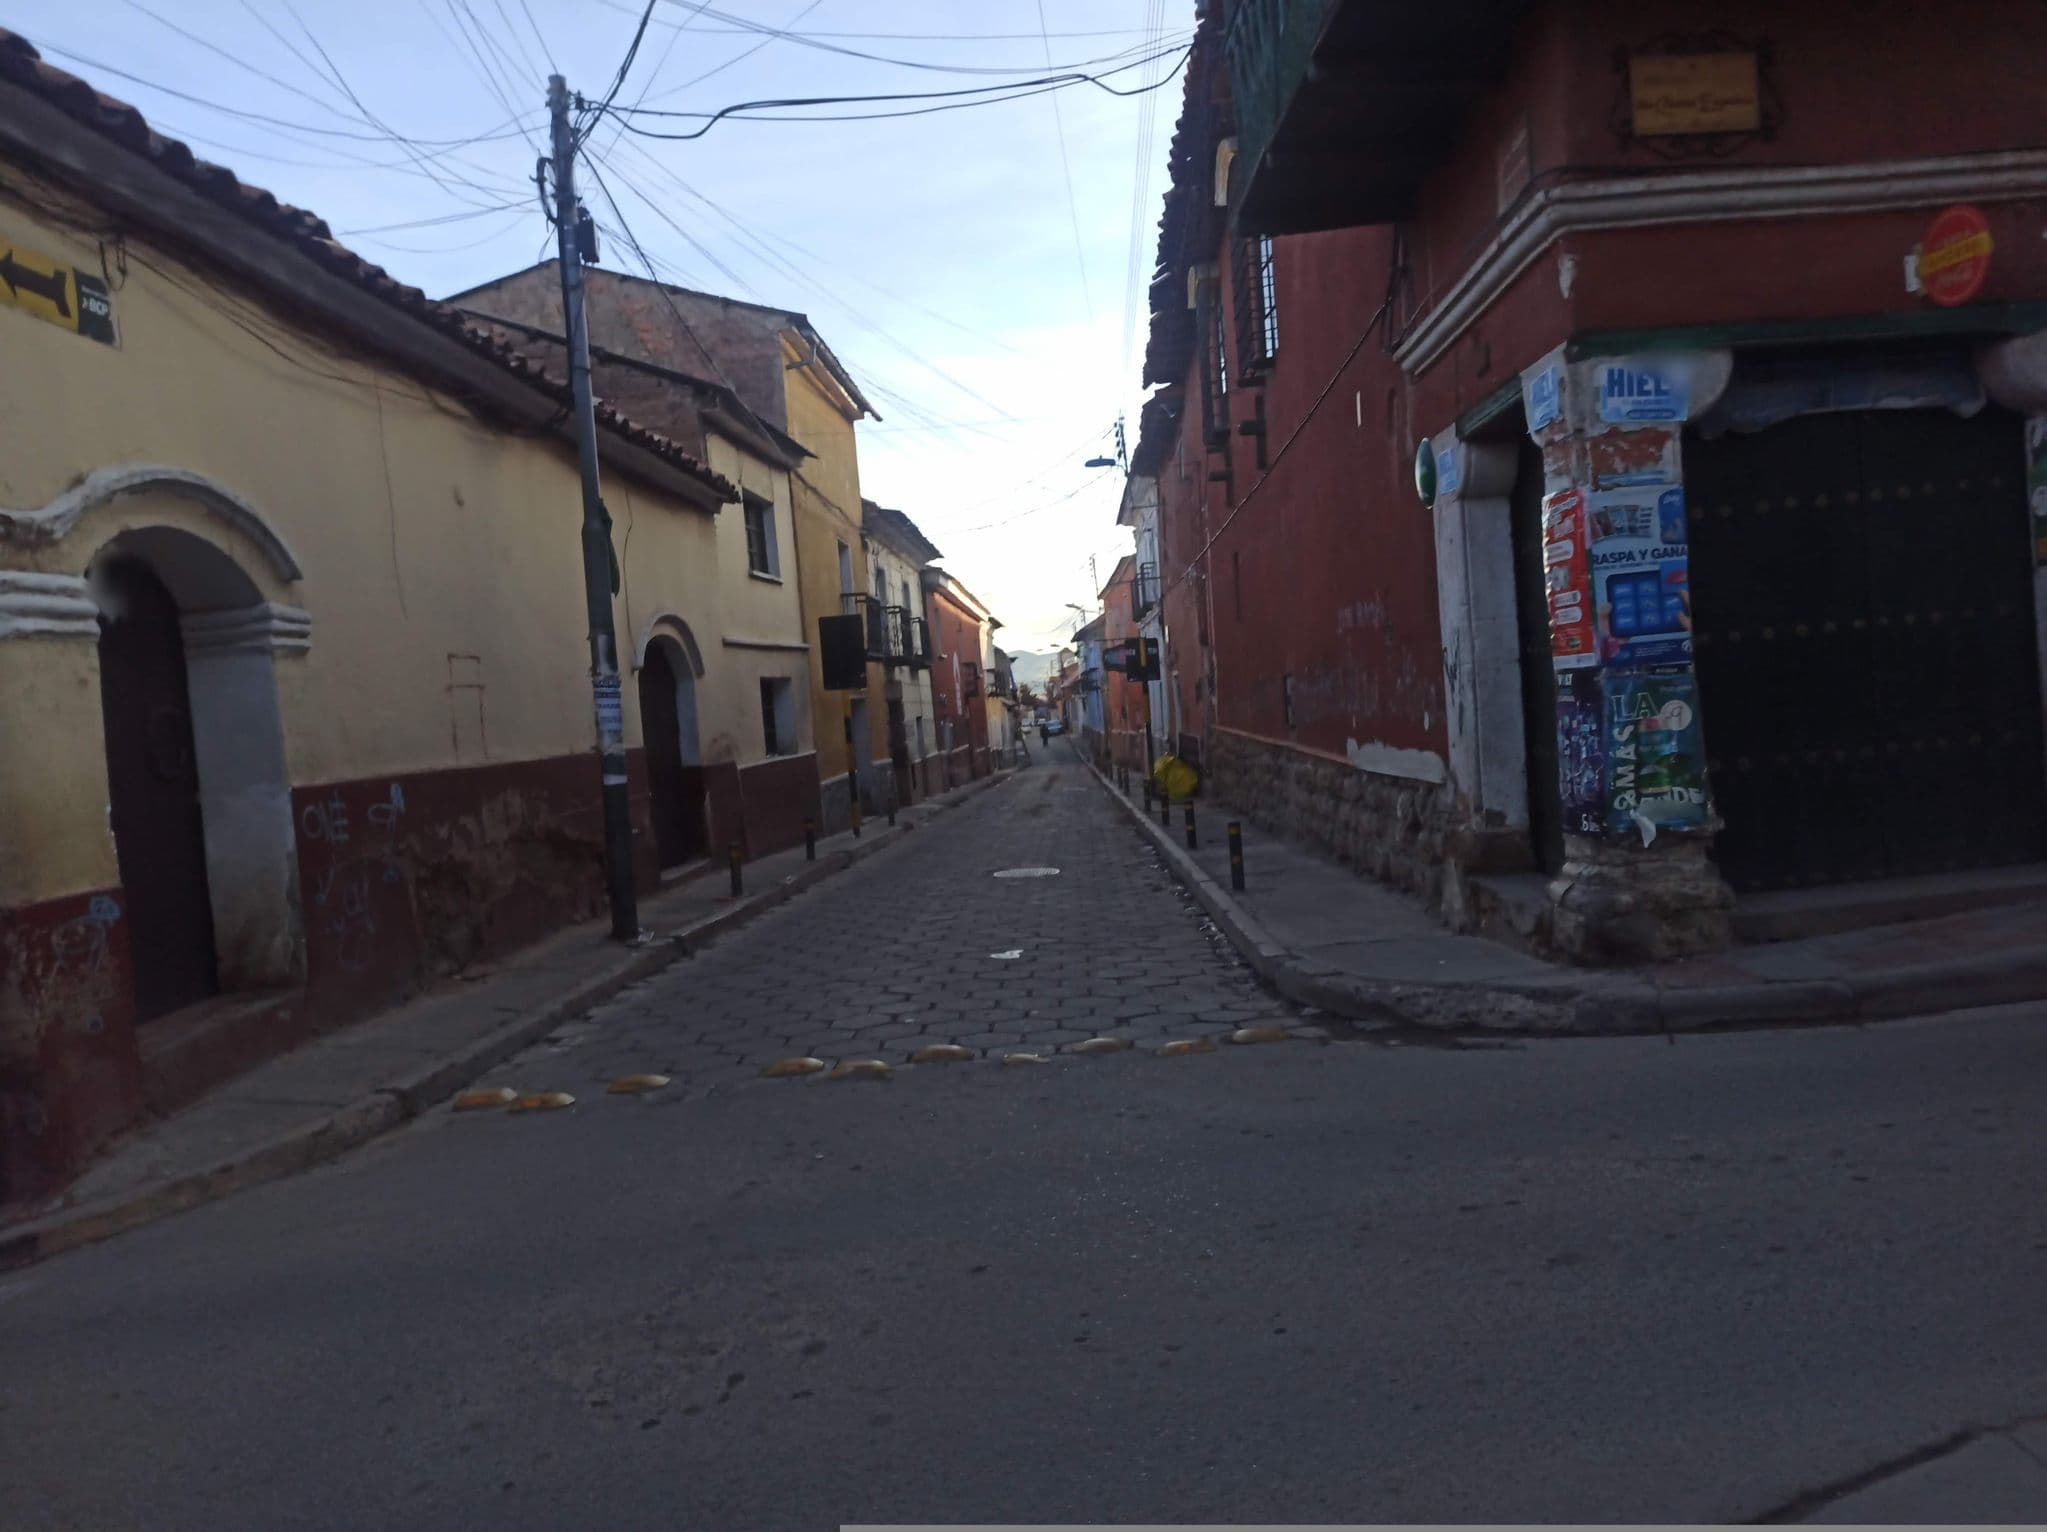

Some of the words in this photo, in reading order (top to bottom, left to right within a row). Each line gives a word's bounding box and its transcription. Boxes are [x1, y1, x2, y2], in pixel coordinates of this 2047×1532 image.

[1592, 551, 1634, 565] RASPA
[1638, 549, 1649, 561] Y
[1611, 692, 1660, 722] LA
